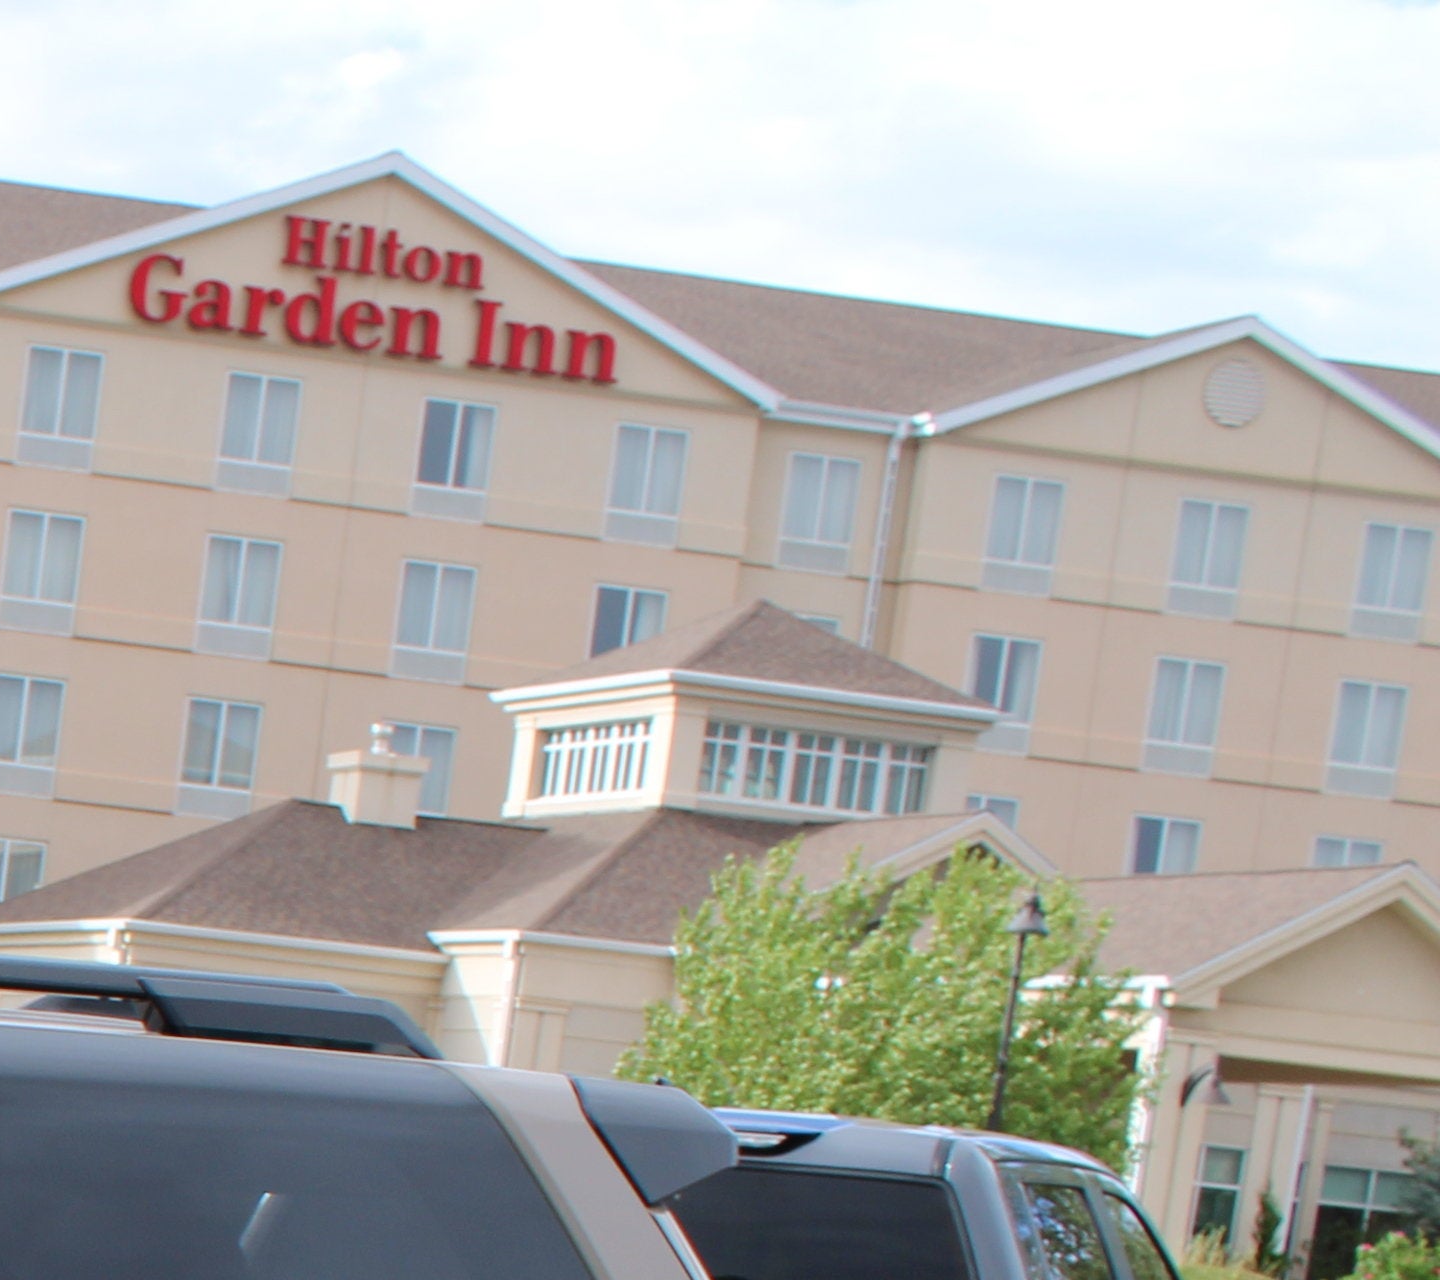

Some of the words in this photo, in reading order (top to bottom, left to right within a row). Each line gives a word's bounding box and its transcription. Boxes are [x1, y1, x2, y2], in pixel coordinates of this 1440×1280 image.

[280, 214, 486, 292] Hilton
[128, 253, 441, 362] Garden
[468, 299, 618, 385] Inn
